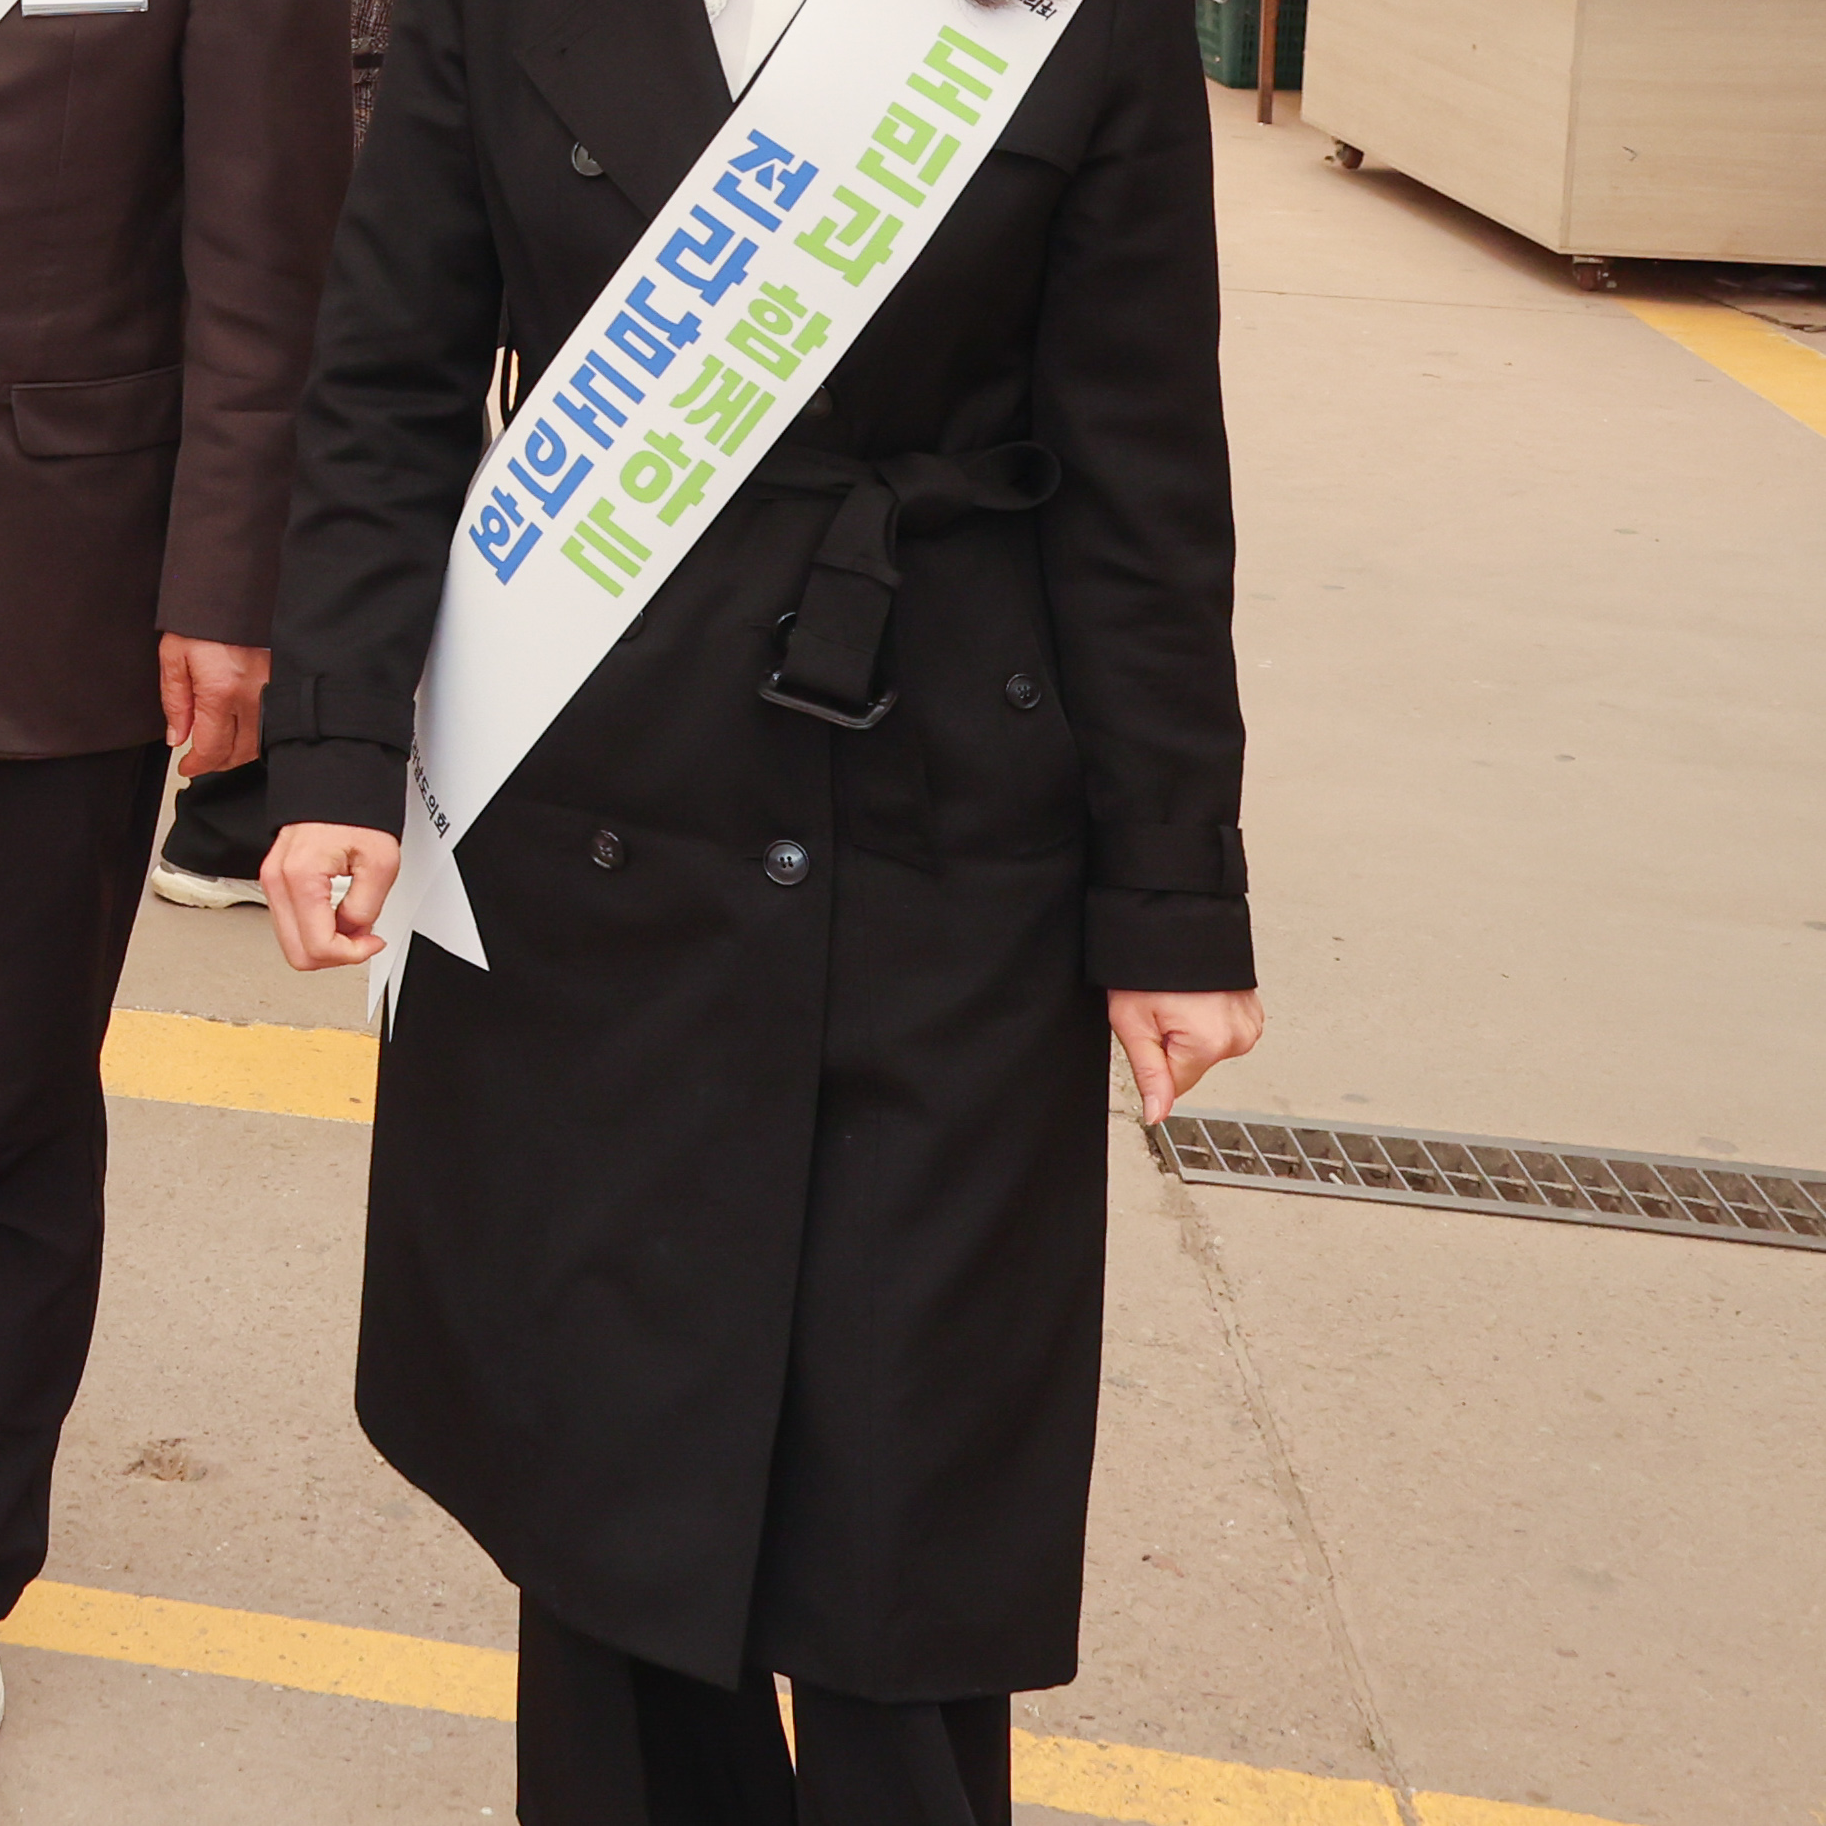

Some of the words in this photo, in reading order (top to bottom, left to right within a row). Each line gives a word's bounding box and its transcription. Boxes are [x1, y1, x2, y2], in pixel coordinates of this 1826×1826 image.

[794, 25, 1011, 286] 도민과
[466, 128, 820, 586] 전라남도의회
[559, 281, 833, 599] 함께하는
